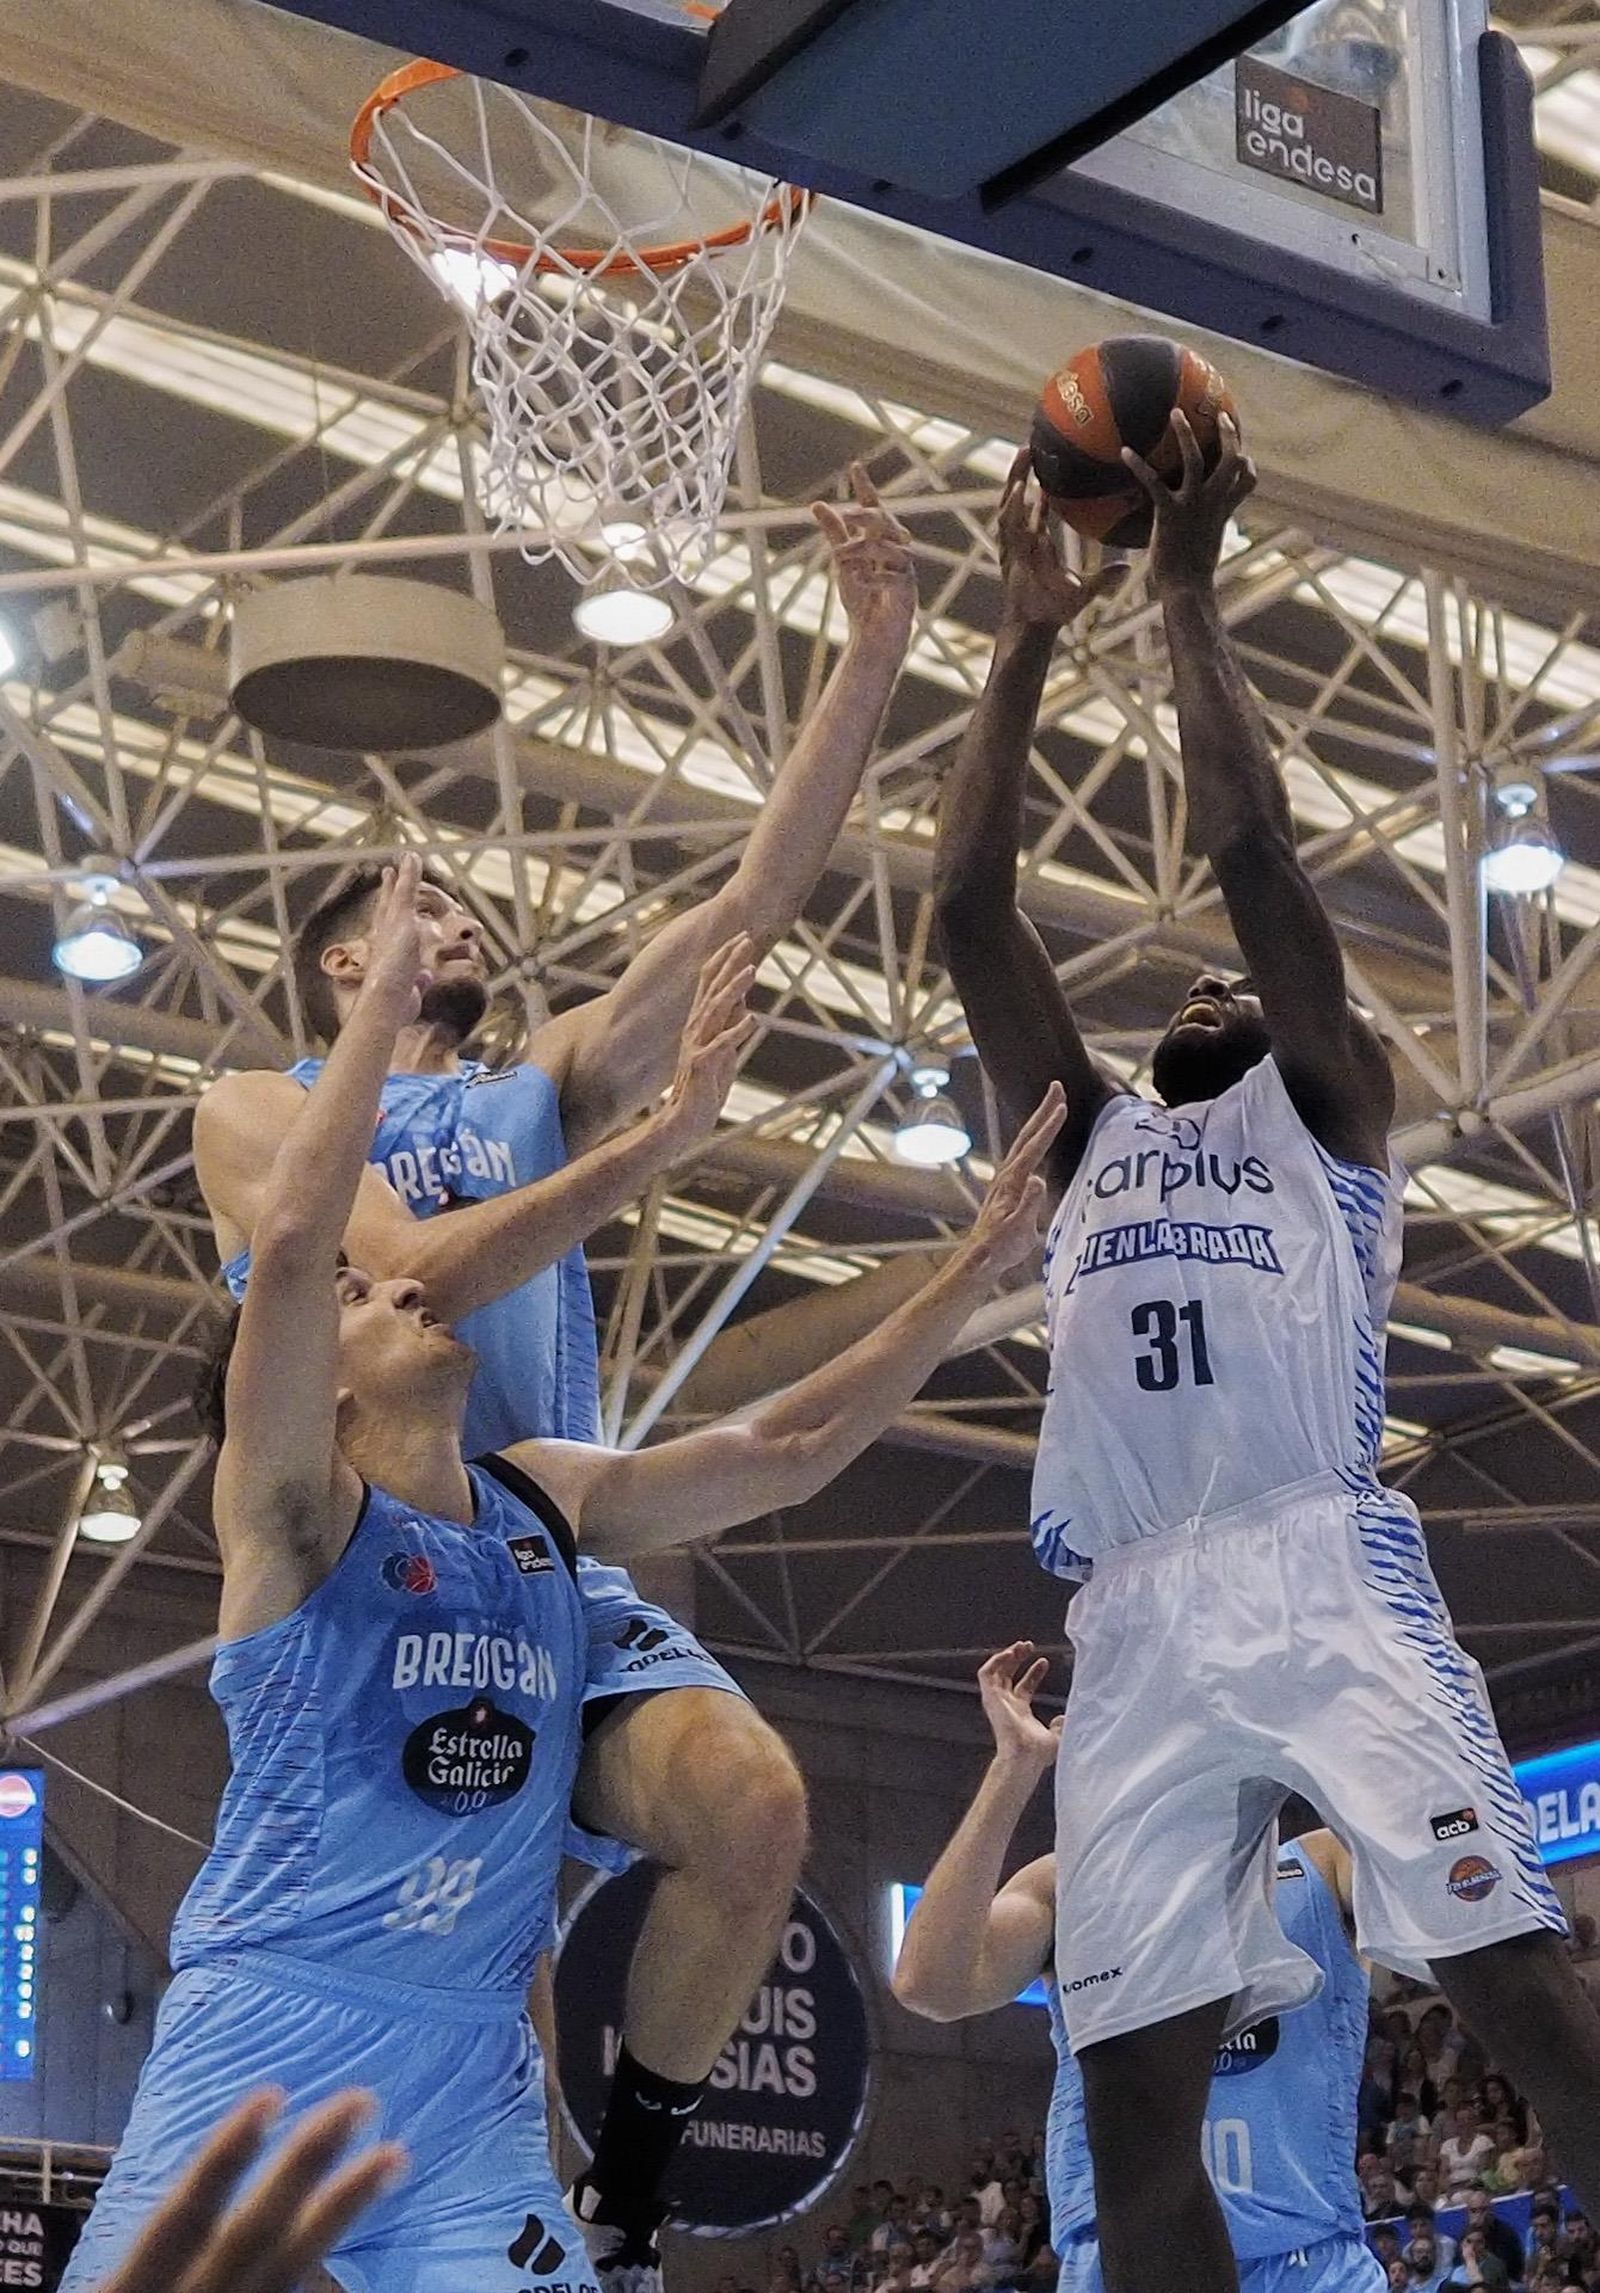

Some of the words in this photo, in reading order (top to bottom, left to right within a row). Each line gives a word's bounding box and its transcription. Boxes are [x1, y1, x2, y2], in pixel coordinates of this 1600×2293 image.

[1244, 88, 1304, 138] liga
[1246, 130, 1376, 201] endesa
[1088, 1150, 1275, 1203] arplus
[1131, 1300, 1215, 1392] 31
[428, 1727, 523, 1760] Estrella
[1437, 1820, 1470, 1838] acb
[740, 1986, 817, 2040] UIS
